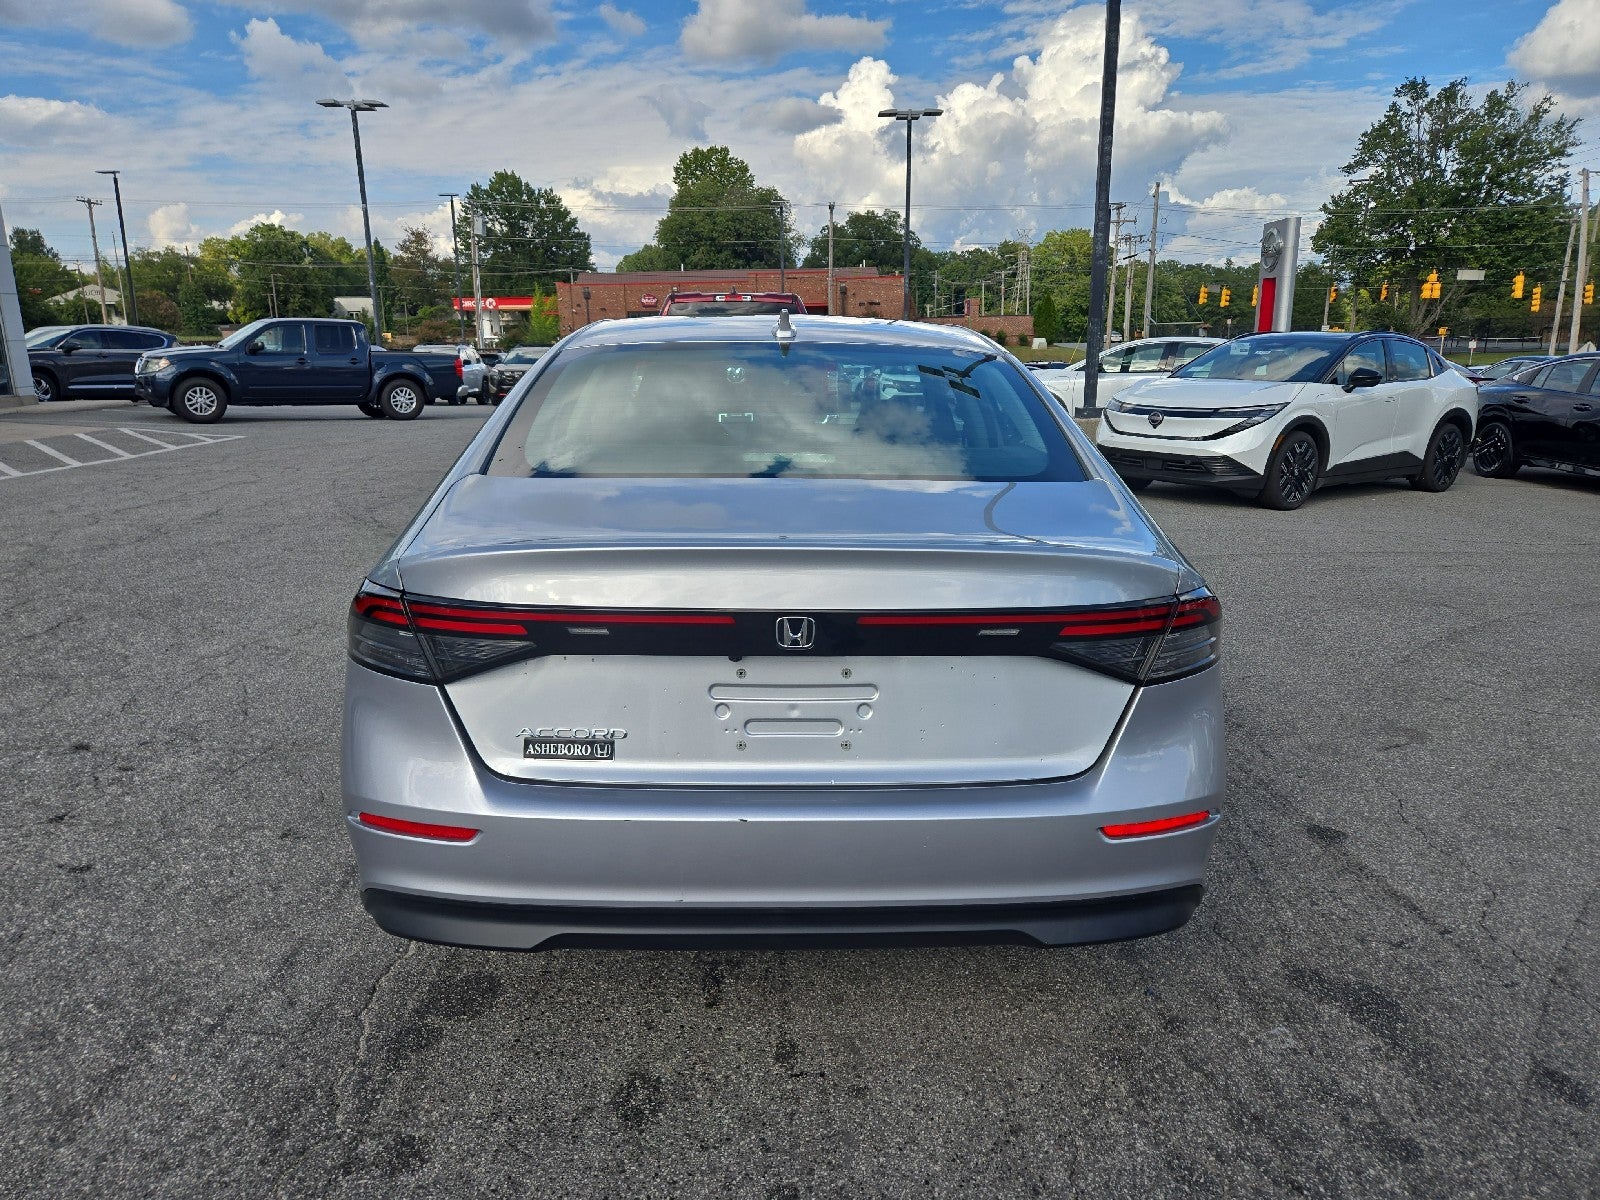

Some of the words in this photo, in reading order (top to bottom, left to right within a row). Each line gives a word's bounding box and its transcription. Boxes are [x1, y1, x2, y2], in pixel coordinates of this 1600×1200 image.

[461, 300, 485, 308] CIRCE
[515, 727, 628, 739] ACCORD
[526, 743, 591, 756] ASHEBORO
